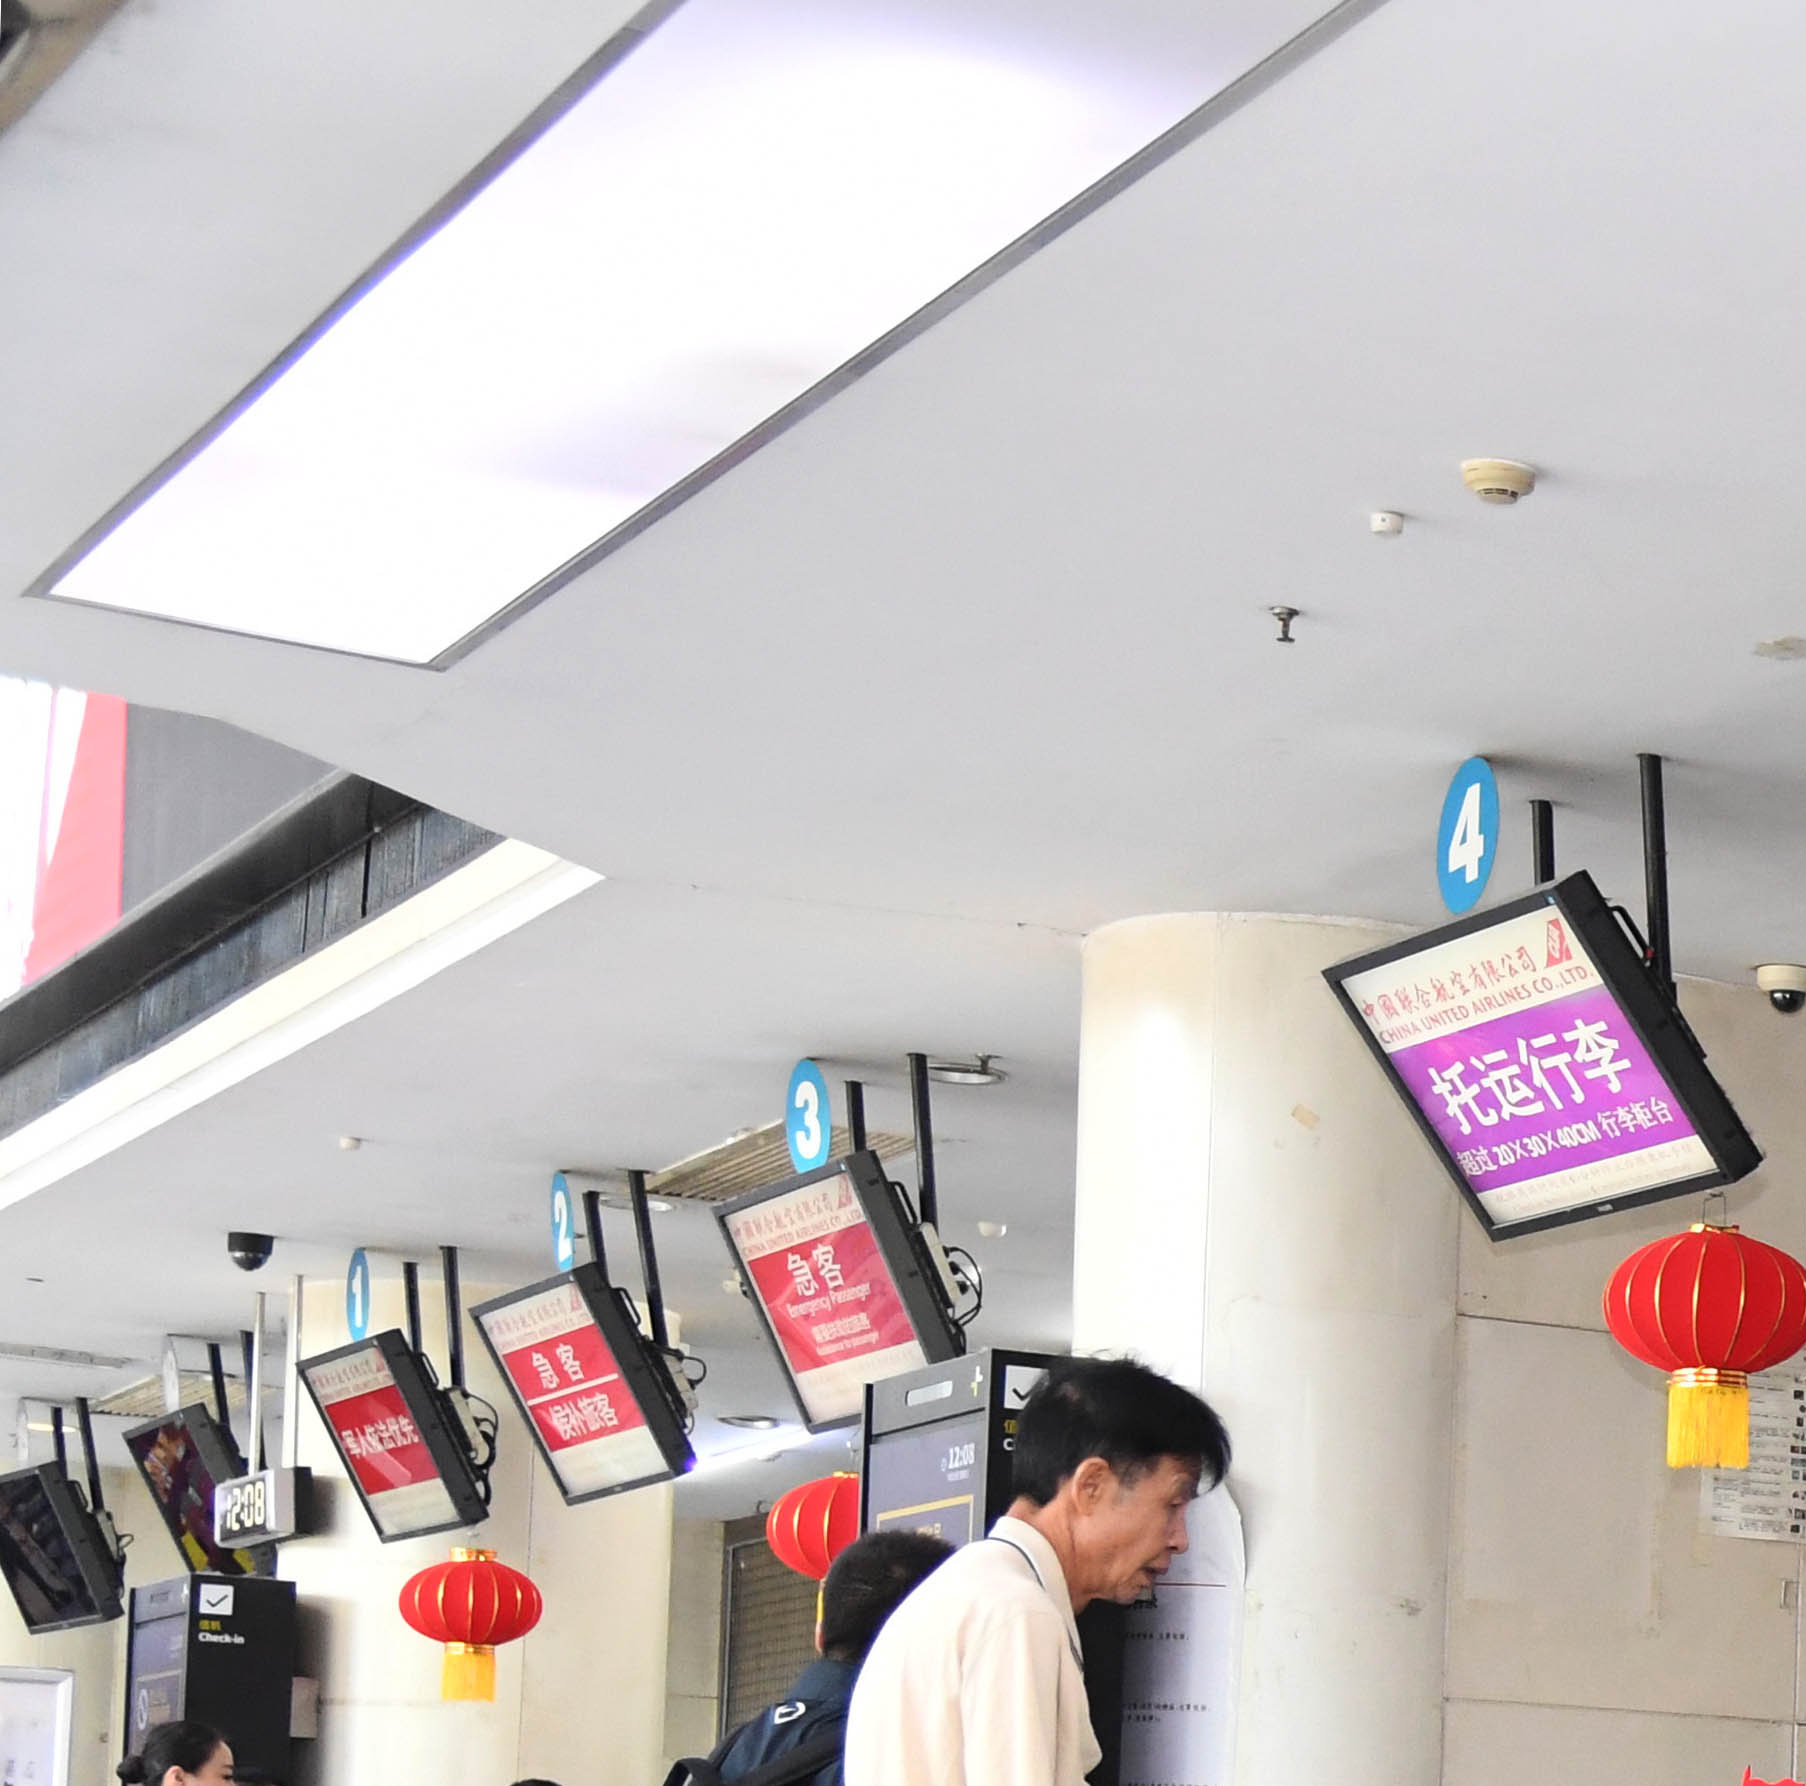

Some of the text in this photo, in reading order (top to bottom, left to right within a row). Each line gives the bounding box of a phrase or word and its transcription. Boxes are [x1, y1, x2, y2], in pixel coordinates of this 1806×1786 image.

[1448, 782, 1484, 884] 4
[1378, 1022, 1422, 1045] CHINA
[1422, 1002, 1471, 1034] UNITED
[1473, 983, 1533, 1018] AIRLINES
[1428, 1018, 1632, 1136] 托运行李
[795, 1080, 821, 1160] 3
[1456, 1144, 1498, 1177] 超过
[1599, 1095, 1674, 1139] 行李柜台
[554, 1190, 572, 1262] 2
[351, 1265, 362, 1328] 1
[787, 1243, 845, 1296] 急客
[226, 1480, 265, 1533] 12:08
[198, 1631, 245, 1644] Check-in
